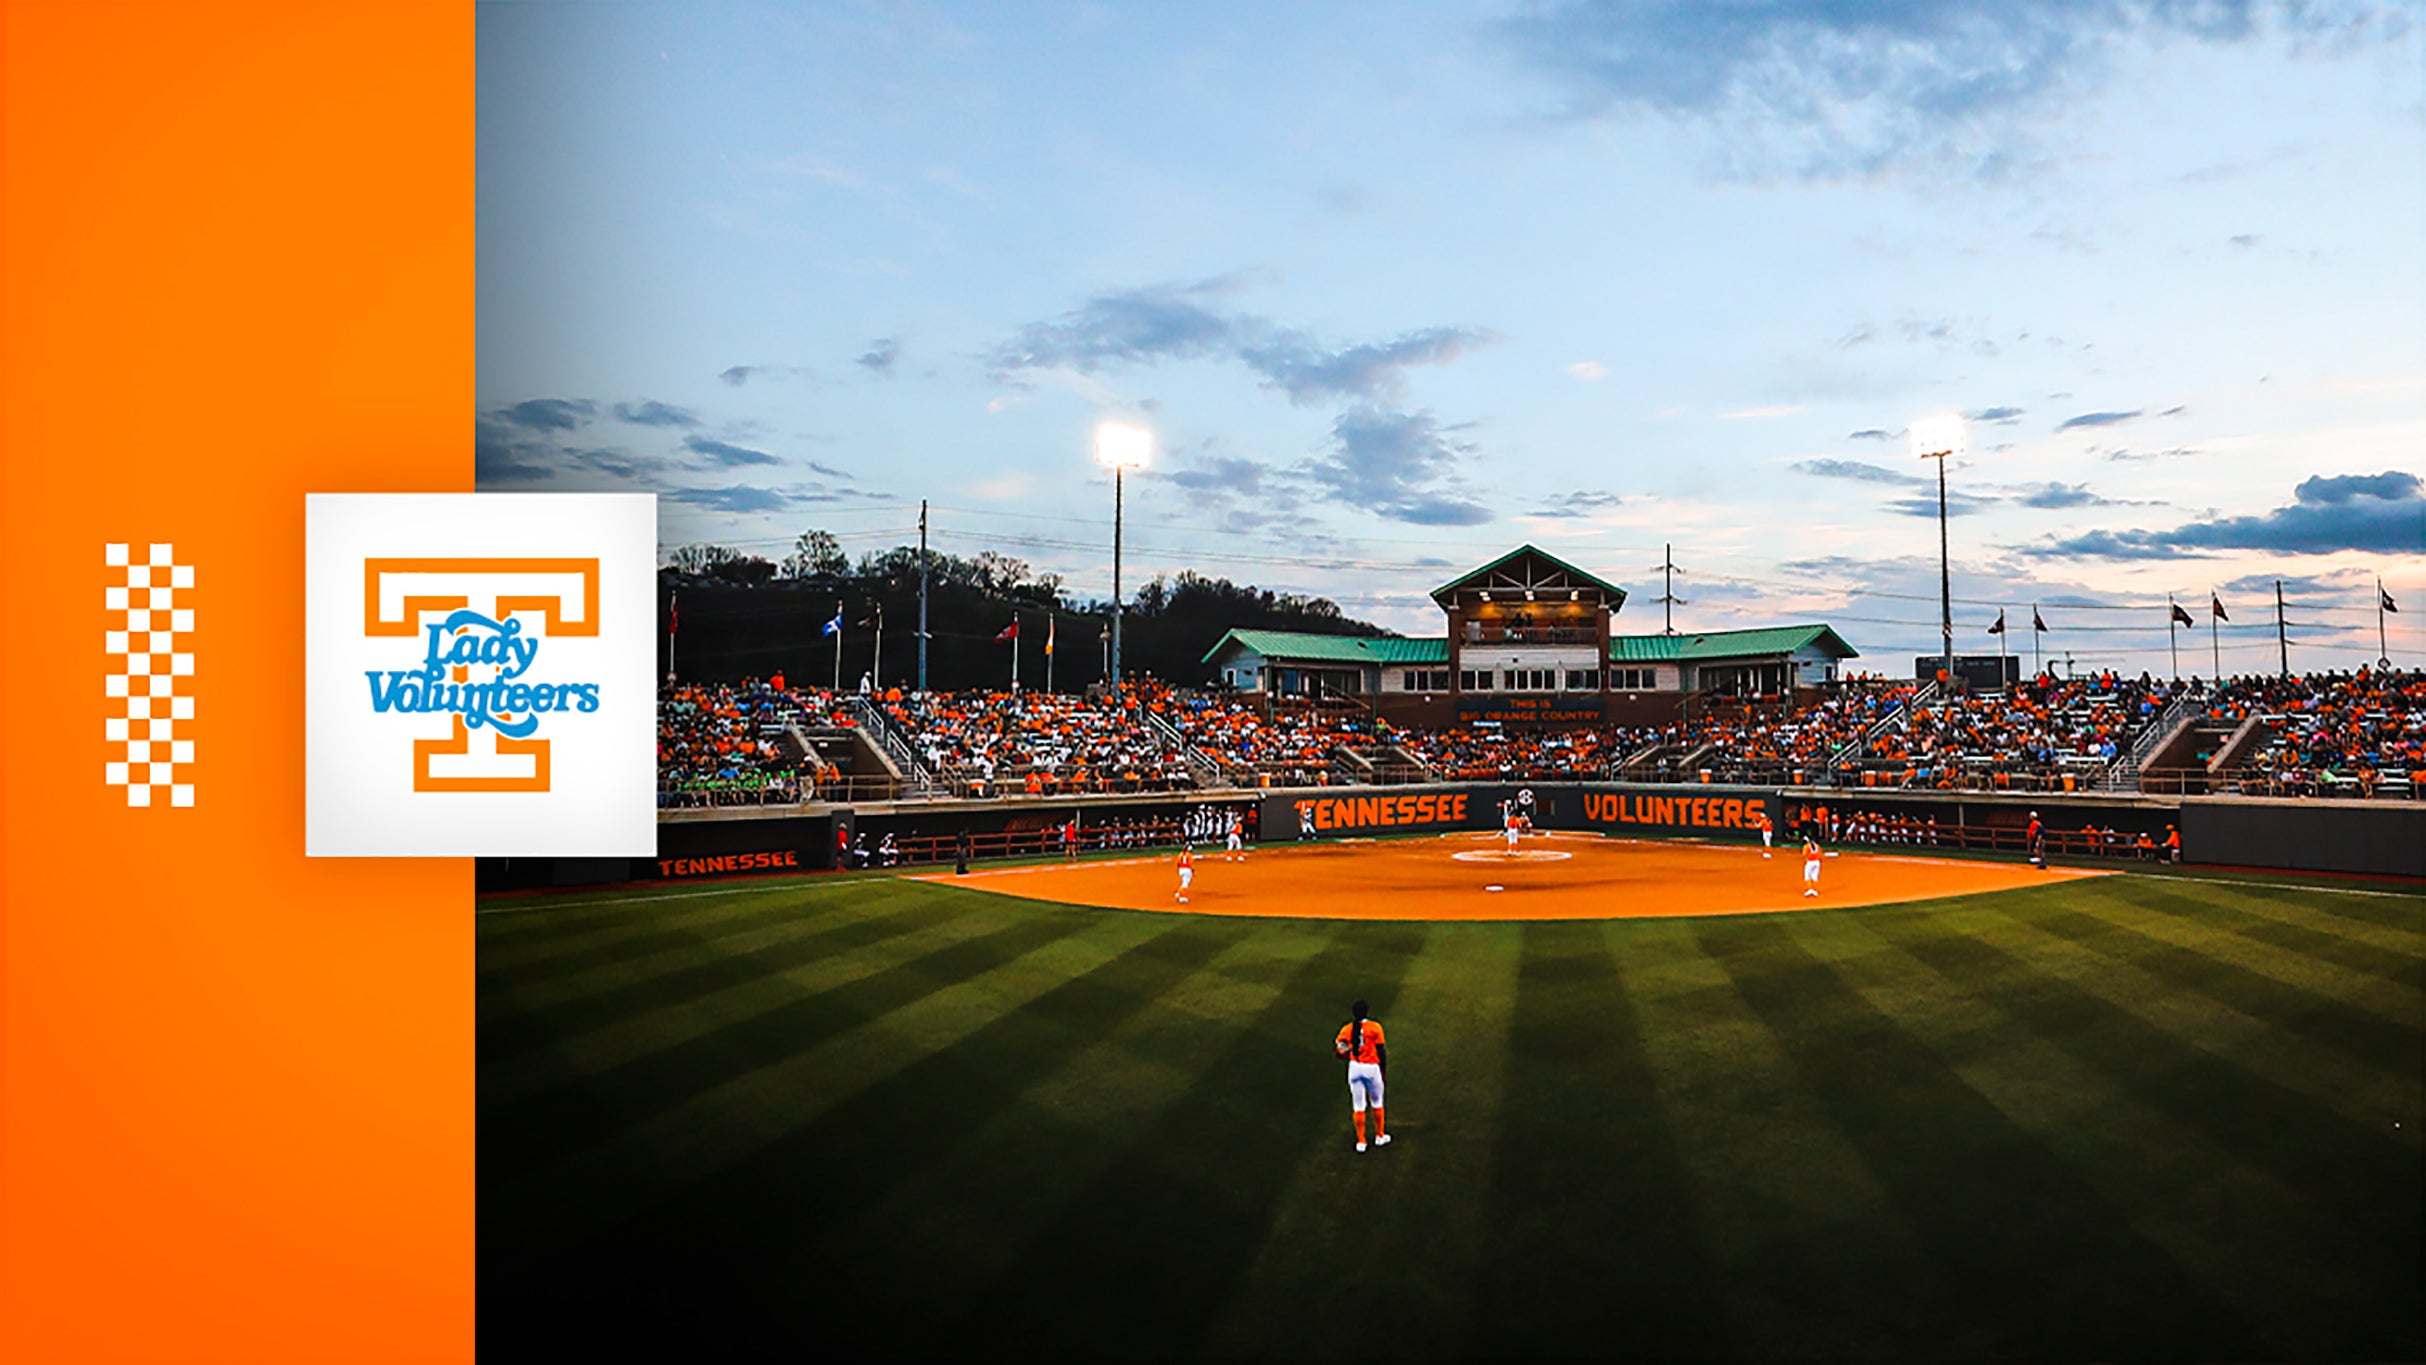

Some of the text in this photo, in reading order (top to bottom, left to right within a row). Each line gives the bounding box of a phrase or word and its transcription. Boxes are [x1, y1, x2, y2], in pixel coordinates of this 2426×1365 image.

[1460, 711, 1600, 721] BIG ORANGE COUNTRY
[1509, 699, 1552, 709] THIS IS
[1294, 794, 1468, 830] TENNESSEE
[1584, 794, 1766, 829] VOLUNTEERS
[658, 851, 798, 876] TENNESSEE
